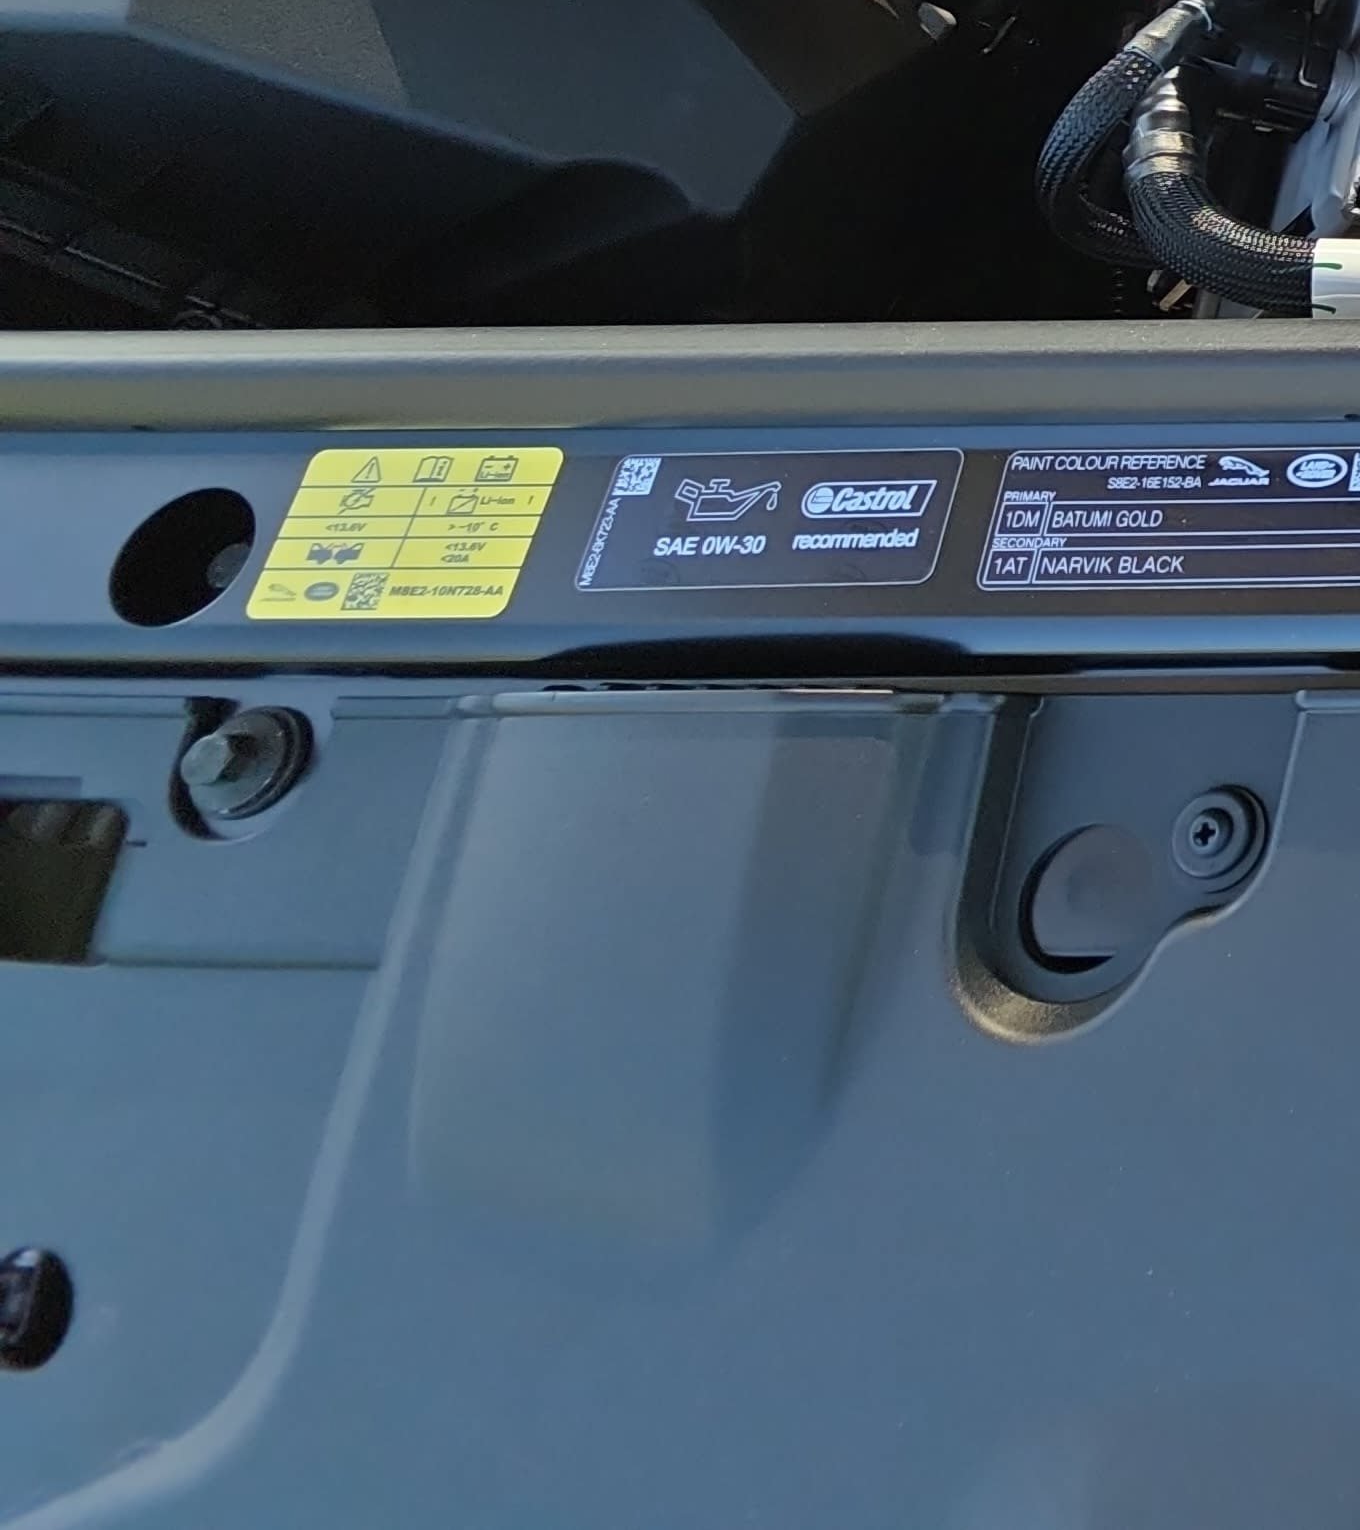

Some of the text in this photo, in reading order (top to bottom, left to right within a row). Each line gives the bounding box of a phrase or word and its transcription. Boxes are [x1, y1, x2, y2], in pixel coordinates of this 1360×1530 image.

[1011, 454, 1208, 471] PAINT COLOUR REFERENCE
[1208, 477, 1270, 486] JAGUAR
[831, 484, 919, 512] Castrol
[1003, 491, 1056, 502] PRIMARY
[1005, 509, 1163, 528] 1DM BATUMI GOLD
[653, 535, 766, 556] SAE 0W-30
[792, 528, 920, 551] recommended
[991, 537, 1067, 548] SECONDARY
[994, 555, 1185, 575] 1AT NARVIK BLACK
